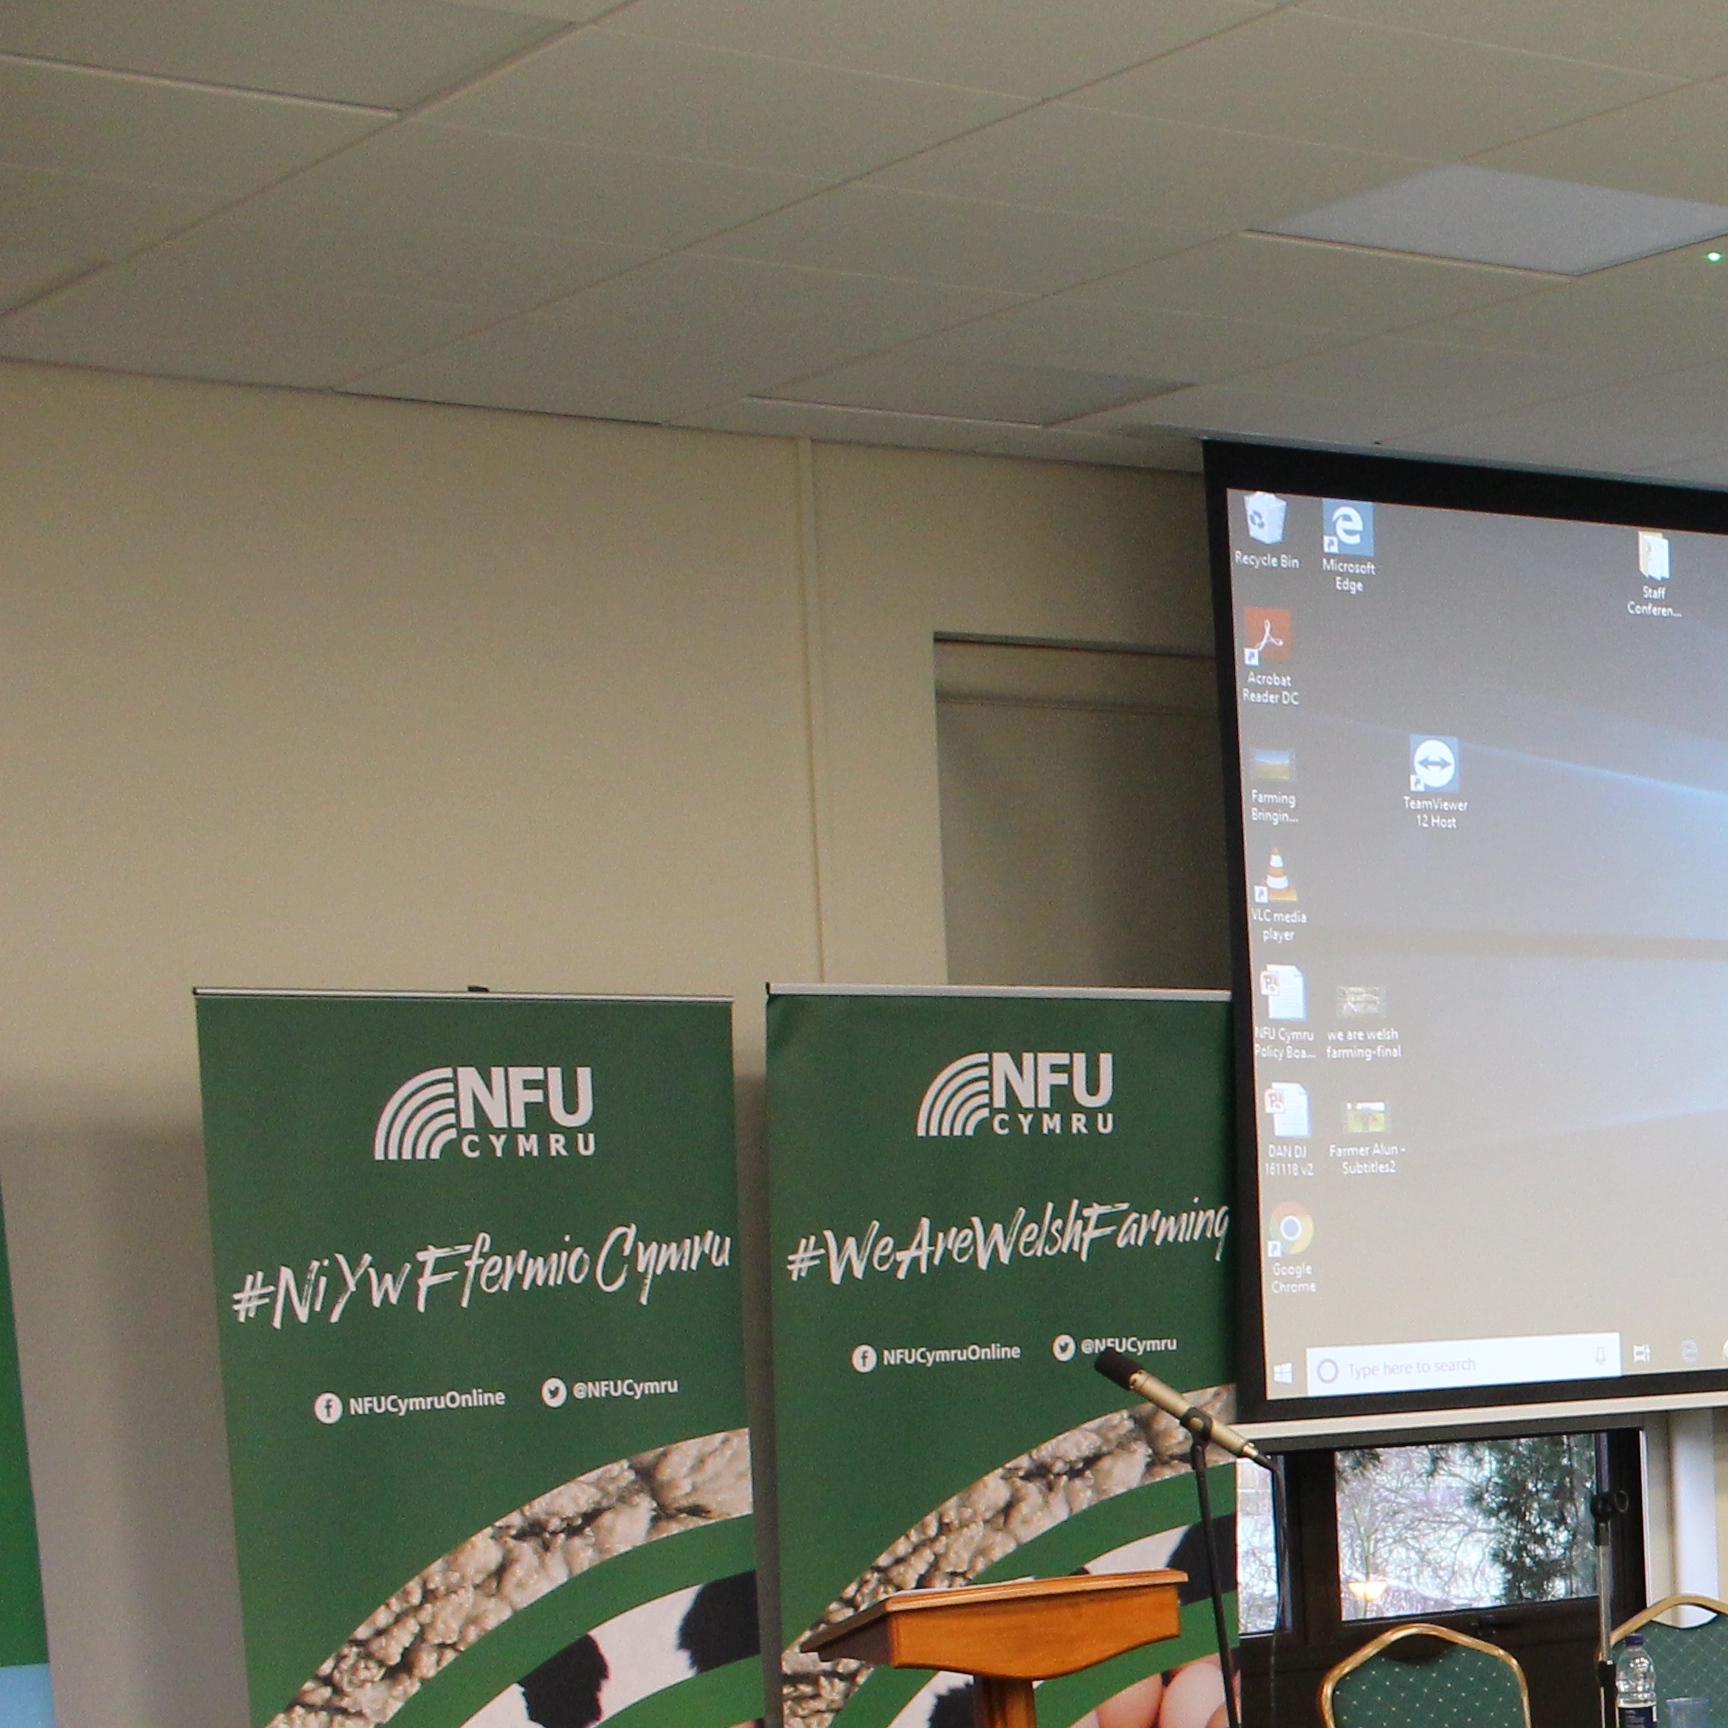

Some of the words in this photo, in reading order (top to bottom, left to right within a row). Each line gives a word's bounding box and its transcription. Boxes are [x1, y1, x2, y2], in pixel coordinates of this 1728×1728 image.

[1235, 551, 1277, 569] Recycle
[1280, 554, 1299, 568] Bin
[1322, 558, 1376, 575] Microsoft
[1335, 576, 1364, 594] Edge
[1642, 585, 1666, 600] Staff
[1248, 671, 1291, 687] Acrobat
[1242, 688, 1280, 703] Reader
[1281, 691, 1299, 705] DC
[1251, 790, 1296, 809] Farming
[1403, 796, 1468, 812] TeamViewer
[1417, 815, 1428, 827] 12
[1431, 815, 1457, 829] Host
[1251, 908, 1271, 922] VLC
[1274, 910, 1307, 924] media
[1262, 928, 1295, 944] player
[1278, 1027, 1314, 1044] Cymru
[1327, 1031, 1345, 1041] we
[1347, 1030, 1364, 1041] are
[1366, 1028, 1399, 1041] welsh
[1255, 1044, 1284, 1061] Policy
[1326, 1045, 1402, 1061] farming-final
[991, 1052, 1114, 1109] NFU
[456, 1066, 595, 1129] NFU
[993, 1112, 1115, 1136] CYMRU
[461, 1133, 596, 1157] CYMRU
[1268, 1144, 1292, 1158] DAN
[1329, 1144, 1370, 1157] Farmer
[1372, 1143, 1398, 1156] Alun
[1342, 1160, 1396, 1175] Subtitles2
[786, 1196, 1230, 1285] #WeAreWelshFarming
[1272, 1263, 1312, 1278] Google
[1271, 1280, 1317, 1293] Chrome
[882, 1343, 1021, 1367] NFUCymruOnline
[1348, 1363, 1379, 1380] Type
[1383, 1362, 1412, 1375] here
[1416, 1359, 1430, 1373] to
[1434, 1357, 1476, 1372] search
[573, 1377, 678, 1402] @NFUCymru
[349, 1389, 505, 1418] NFUCymruOnline
